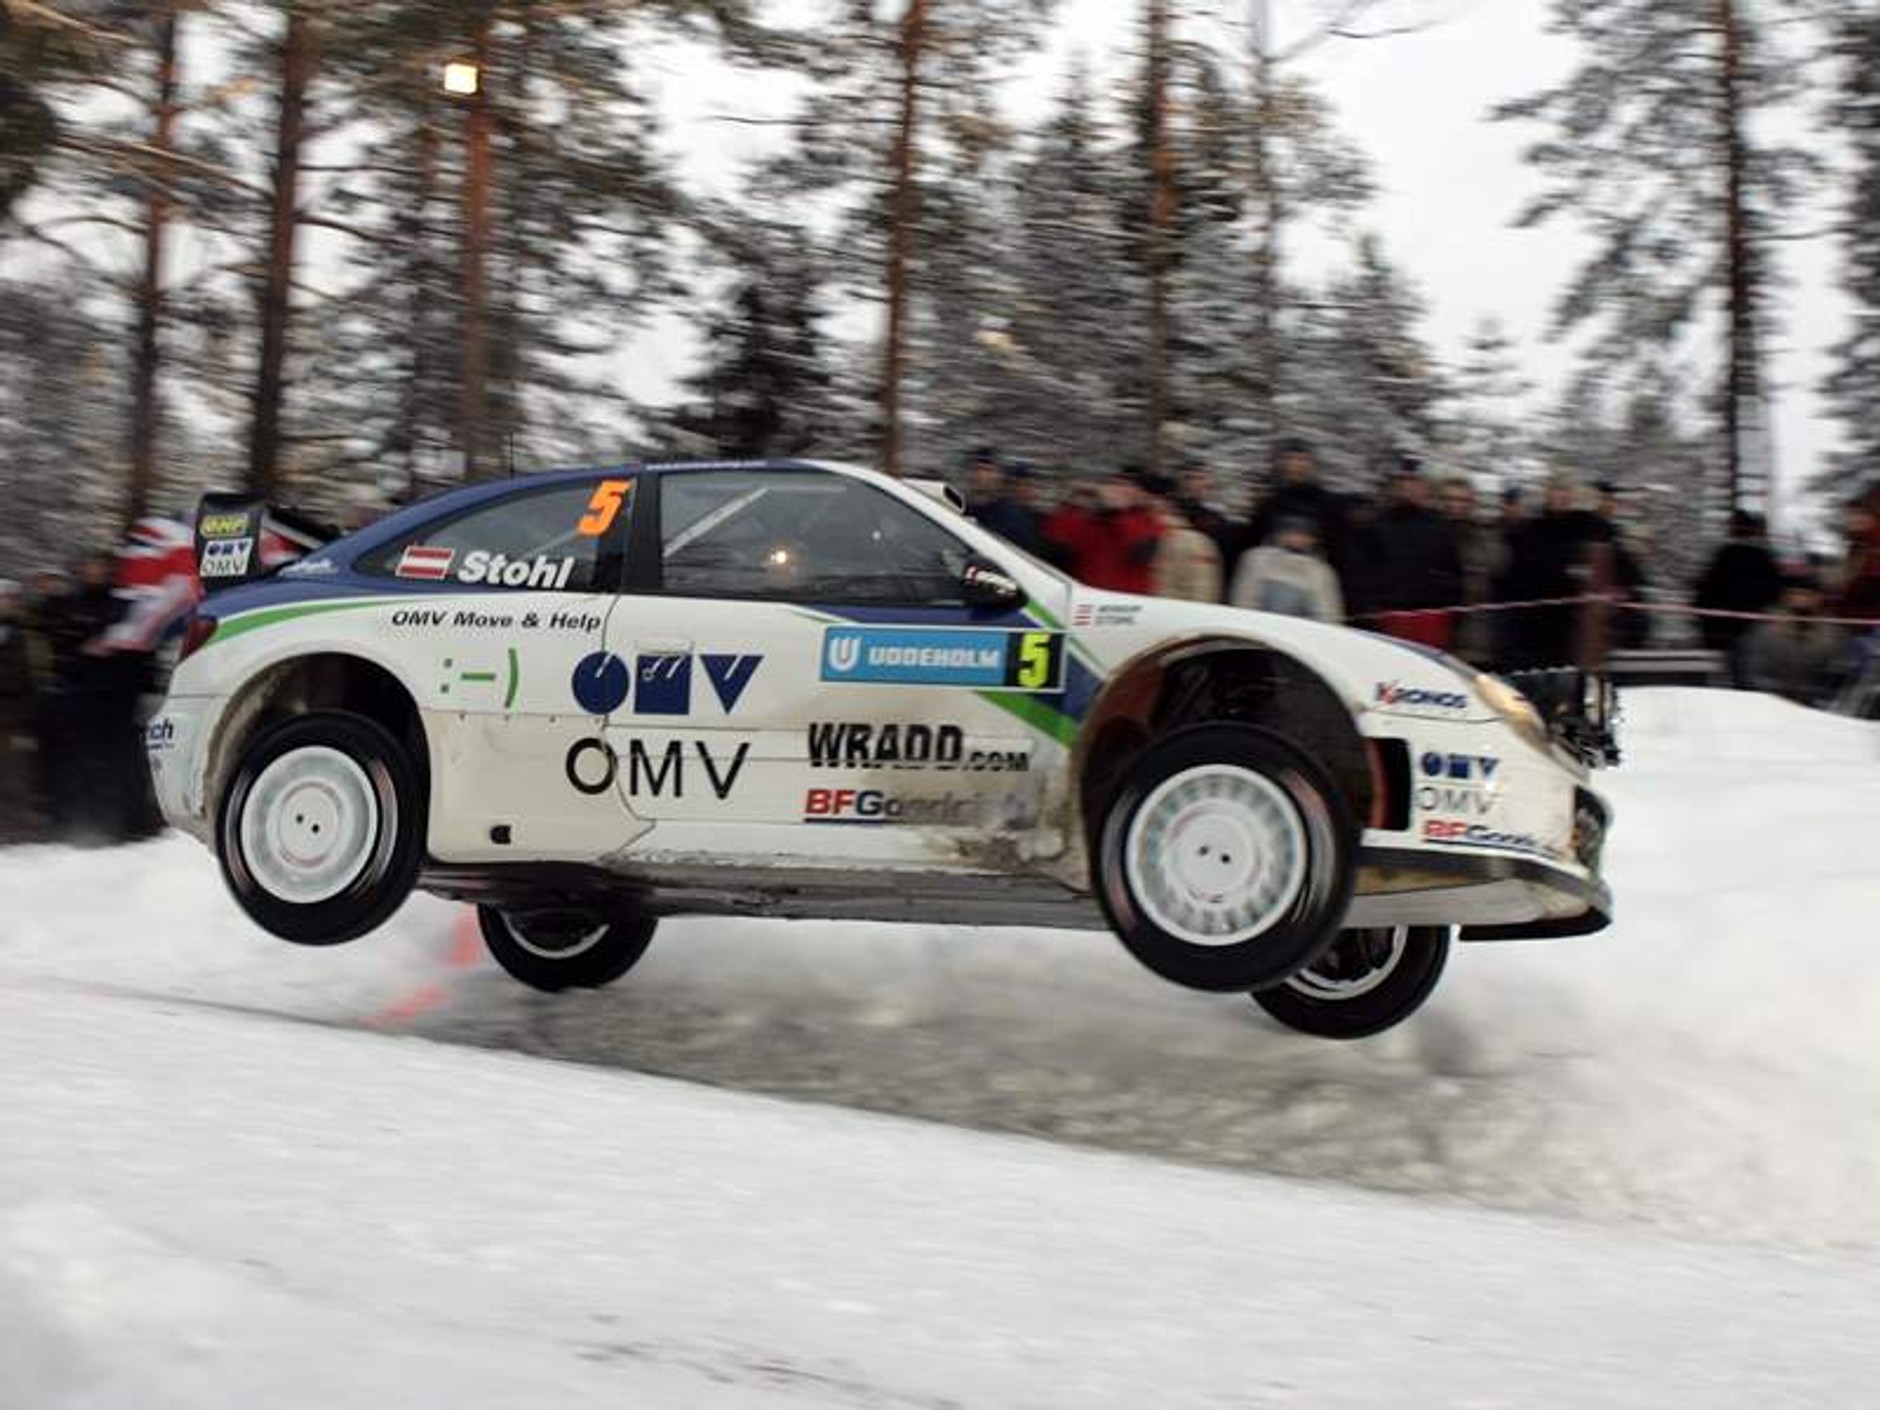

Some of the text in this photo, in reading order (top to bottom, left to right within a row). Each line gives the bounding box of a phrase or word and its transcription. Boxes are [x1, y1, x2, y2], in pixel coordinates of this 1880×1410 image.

[579, 480, 631, 535] 5
[457, 550, 576, 589] Stohl
[391, 611, 601, 632] OMV Move & Help
[868, 646, 1000, 669] UDDEHOLM
[1018, 632, 1050, 689] 5
[565, 737, 752, 800] OMV
[1419, 787, 1504, 814] OMV
